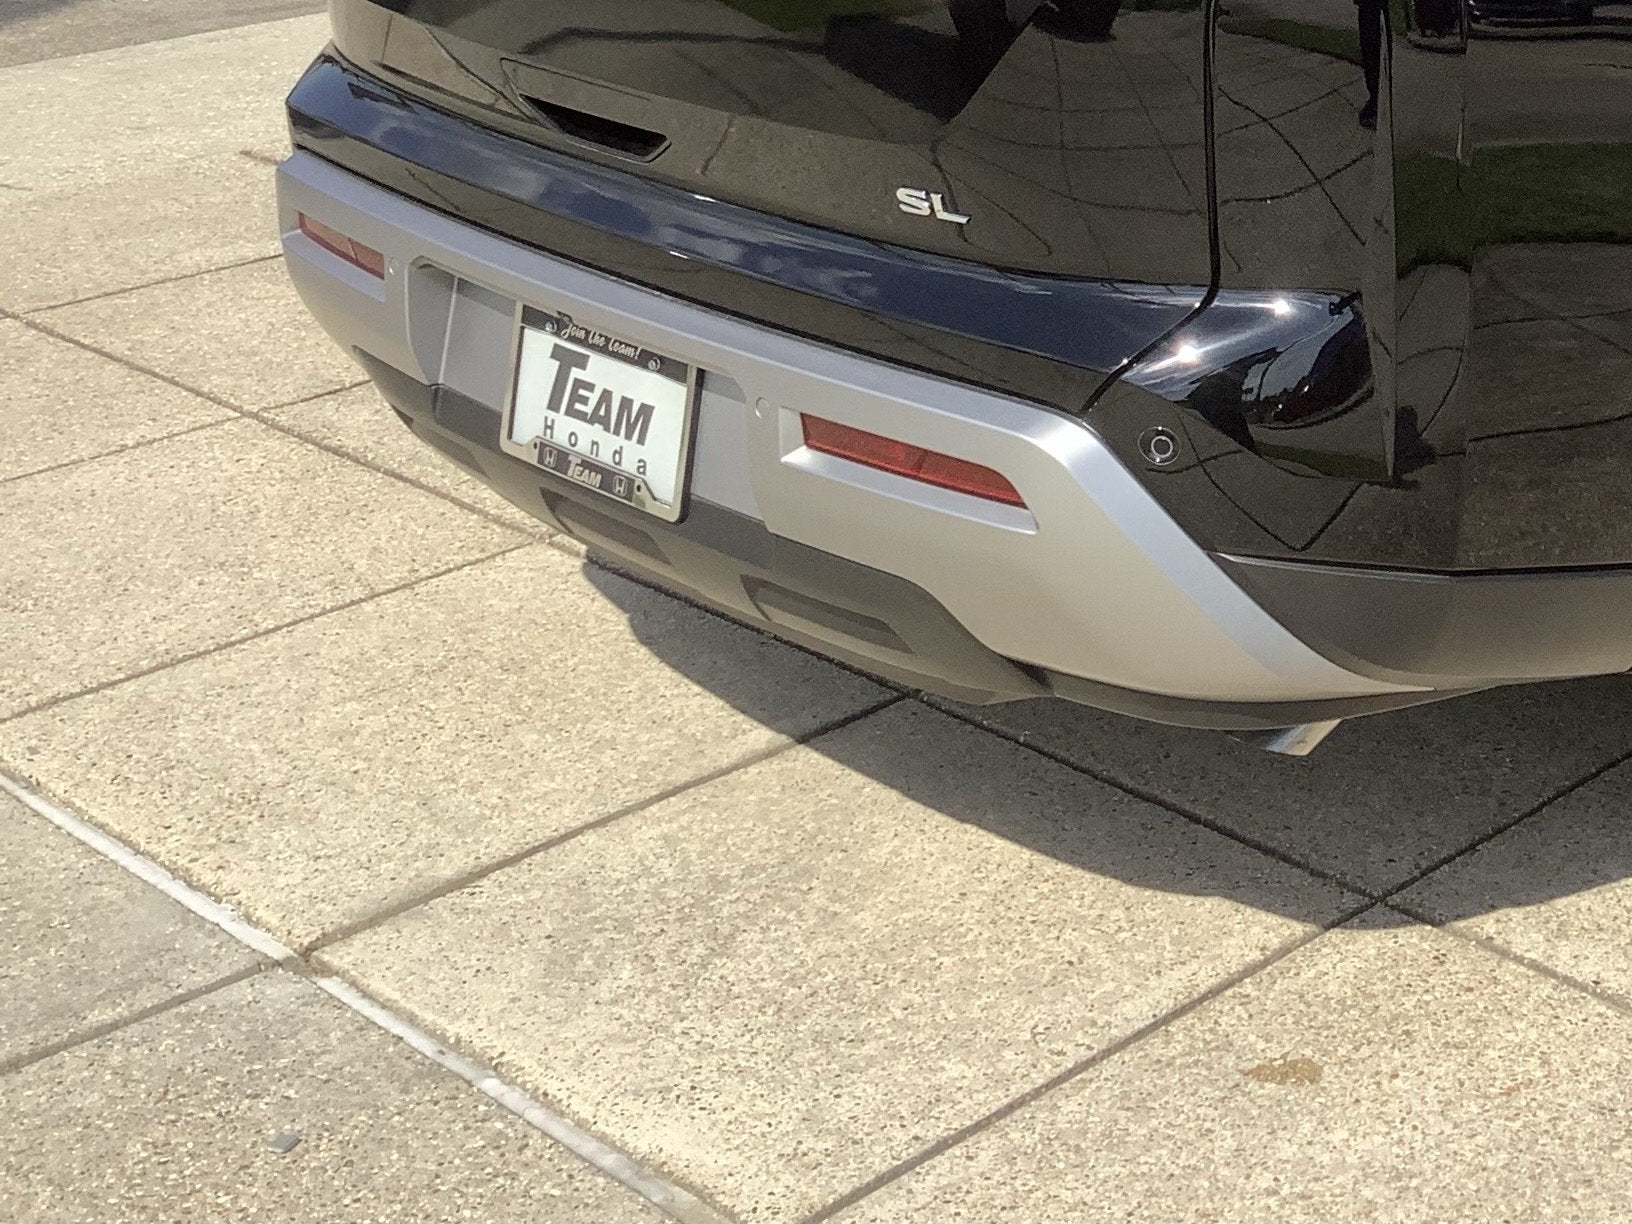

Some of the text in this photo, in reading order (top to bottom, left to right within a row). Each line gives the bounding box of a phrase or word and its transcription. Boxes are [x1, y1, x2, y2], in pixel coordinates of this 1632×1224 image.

[896, 187, 971, 224] SL
[561, 322, 586, 340] Join
[588, 329, 607, 347] the
[546, 343, 655, 446] TEAM
[544, 416, 647, 475] Honda
[567, 456, 602, 488] TEAM
